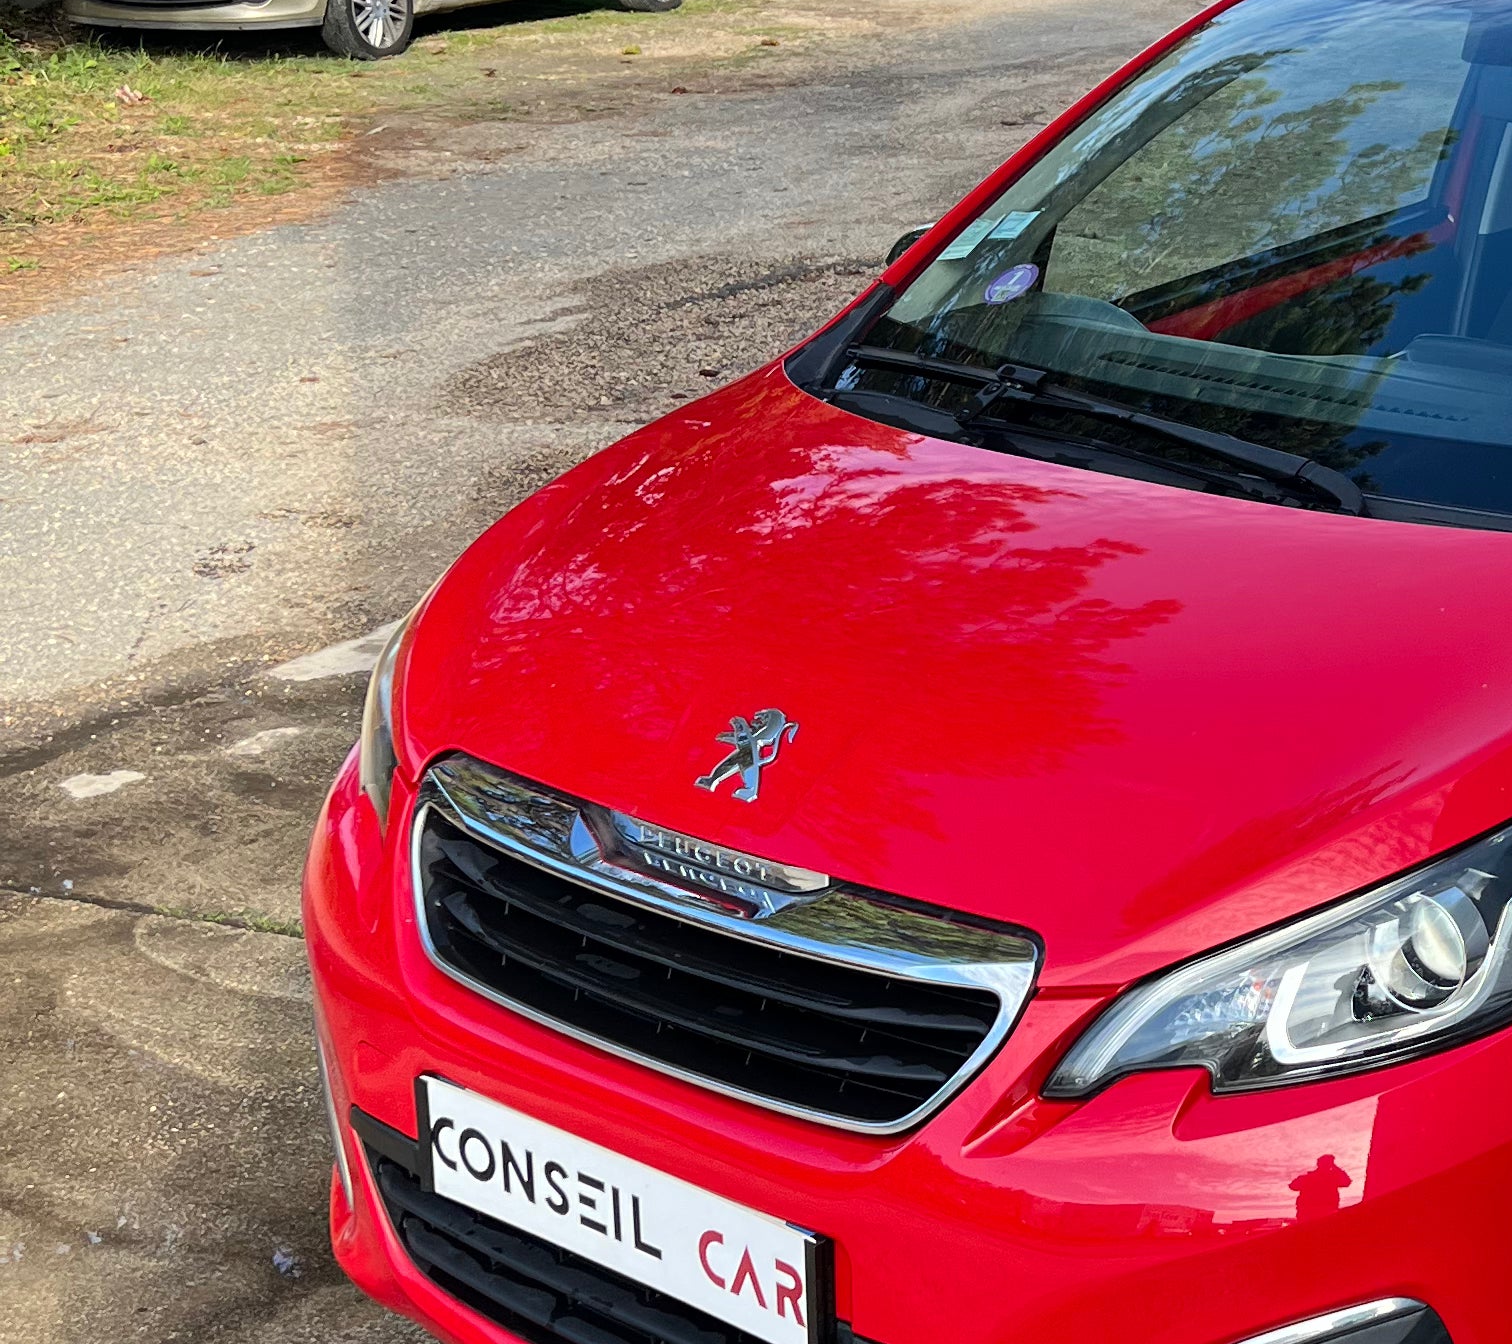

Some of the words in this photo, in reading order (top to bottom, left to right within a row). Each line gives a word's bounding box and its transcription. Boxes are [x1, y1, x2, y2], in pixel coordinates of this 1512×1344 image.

[638, 824, 776, 884] PEUGEOT
[431, 1116, 663, 1261] CONSEIL
[698, 1230, 806, 1328] CAR
